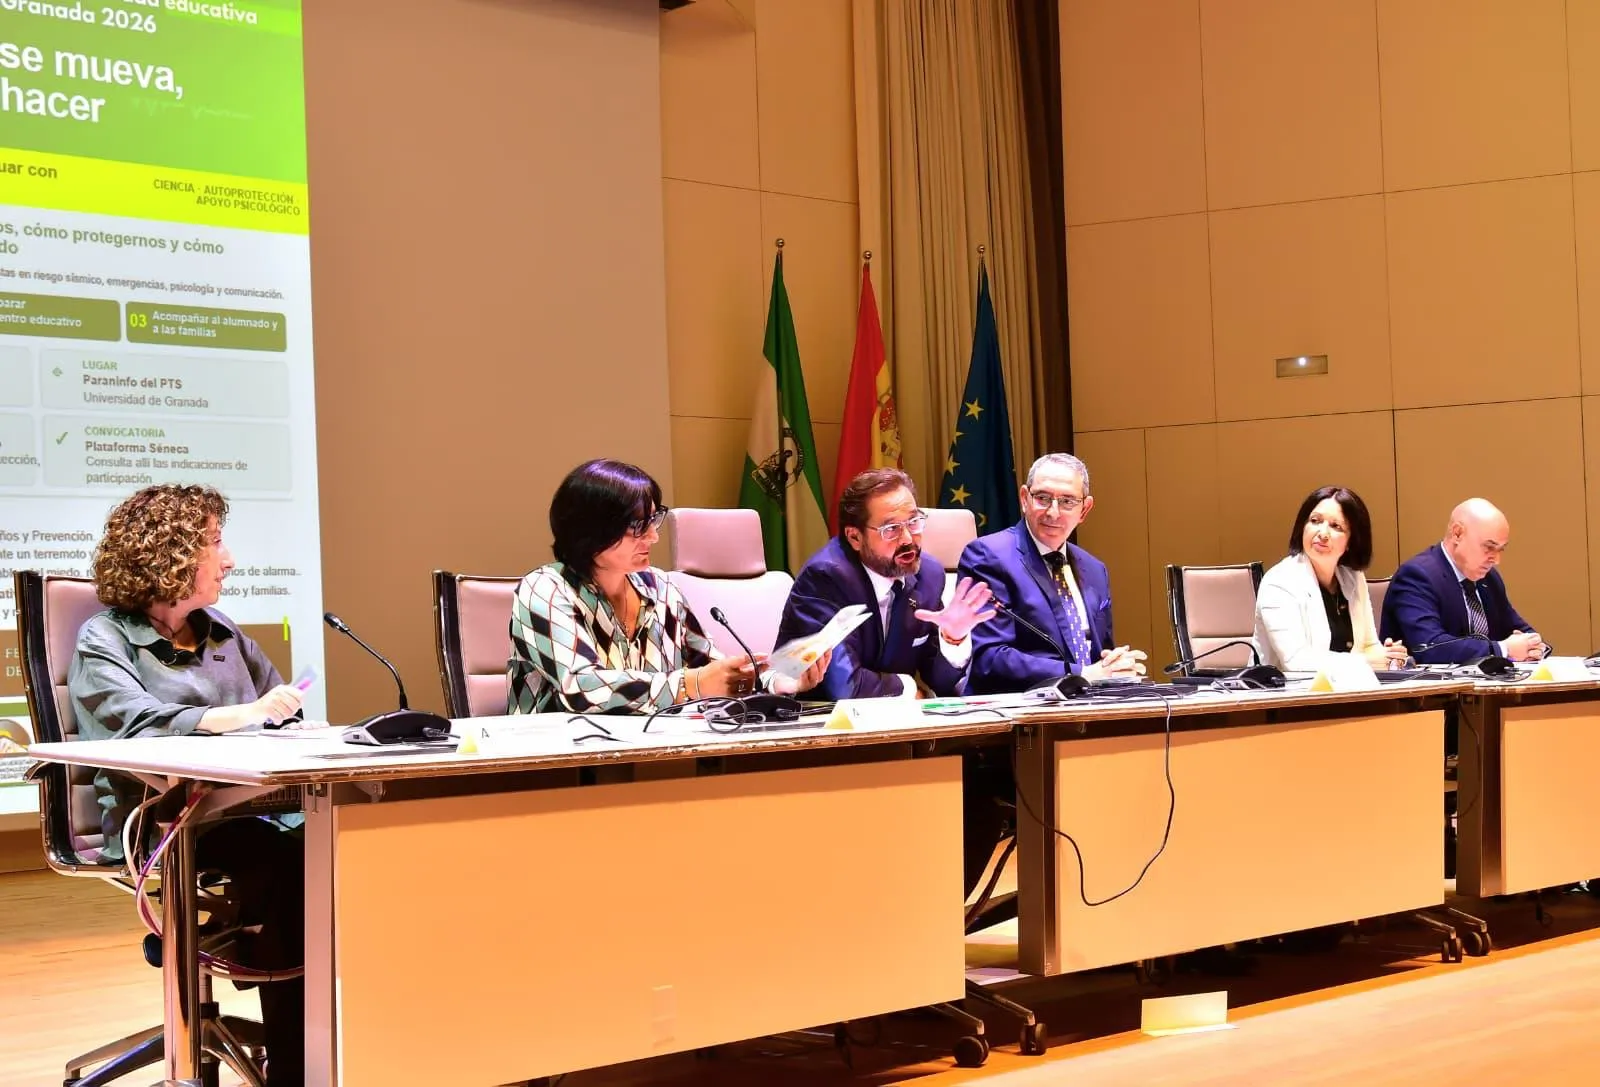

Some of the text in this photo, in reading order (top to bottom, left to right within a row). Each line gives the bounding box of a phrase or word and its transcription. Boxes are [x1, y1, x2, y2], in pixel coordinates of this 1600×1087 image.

[1, 0, 156, 33] Granada 2026
[165, 0, 257, 24] educativa
[0, 42, 183, 99] se mueva,
[1, 77, 106, 122] hacer
[28, 165, 58, 178] con
[153, 179, 294, 204] CIENCIA AUTOPROTECCIÓN
[196, 196, 301, 216] APOYO PSICOLÓGICO
[23, 222, 68, 239] cómo
[72, 229, 166, 248] protegernos
[170, 239, 179, 253] y
[183, 238, 224, 254] cómo
[19, 271, 31, 279] en
[33, 270, 63, 283] riesgo
[66, 272, 104, 286] sísmico,
[107, 277, 167, 291] emergencias,
[170, 281, 214, 295] psicología
[217, 287, 222, 296] y
[224, 285, 284, 300] comunicación.
[30, 315, 82, 327] educativo
[130, 313, 147, 328] 03
[152, 311, 278, 331] Acompañar al alumnado y
[153, 323, 216, 337] a las familias
[82, 360, 117, 370] LUGAR
[83, 374, 183, 389] Paraninfo del PTS
[83, 392, 209, 408] Universidad de Granada
[84, 426, 165, 438] CONVOCATORIA
[85, 441, 189, 455] Plataforma Séneca
[86, 456, 132, 468] Consulta
[153, 458, 168, 469] las
[171, 458, 232, 471] indicaciones
[235, 460, 248, 471] de
[86, 472, 152, 485] participación
[22, 532, 29, 543] y
[16, 550, 31, 559] un
[34, 550, 87, 559] terremoto
[247, 566, 260, 576] de
[243, 587, 249, 598] y
